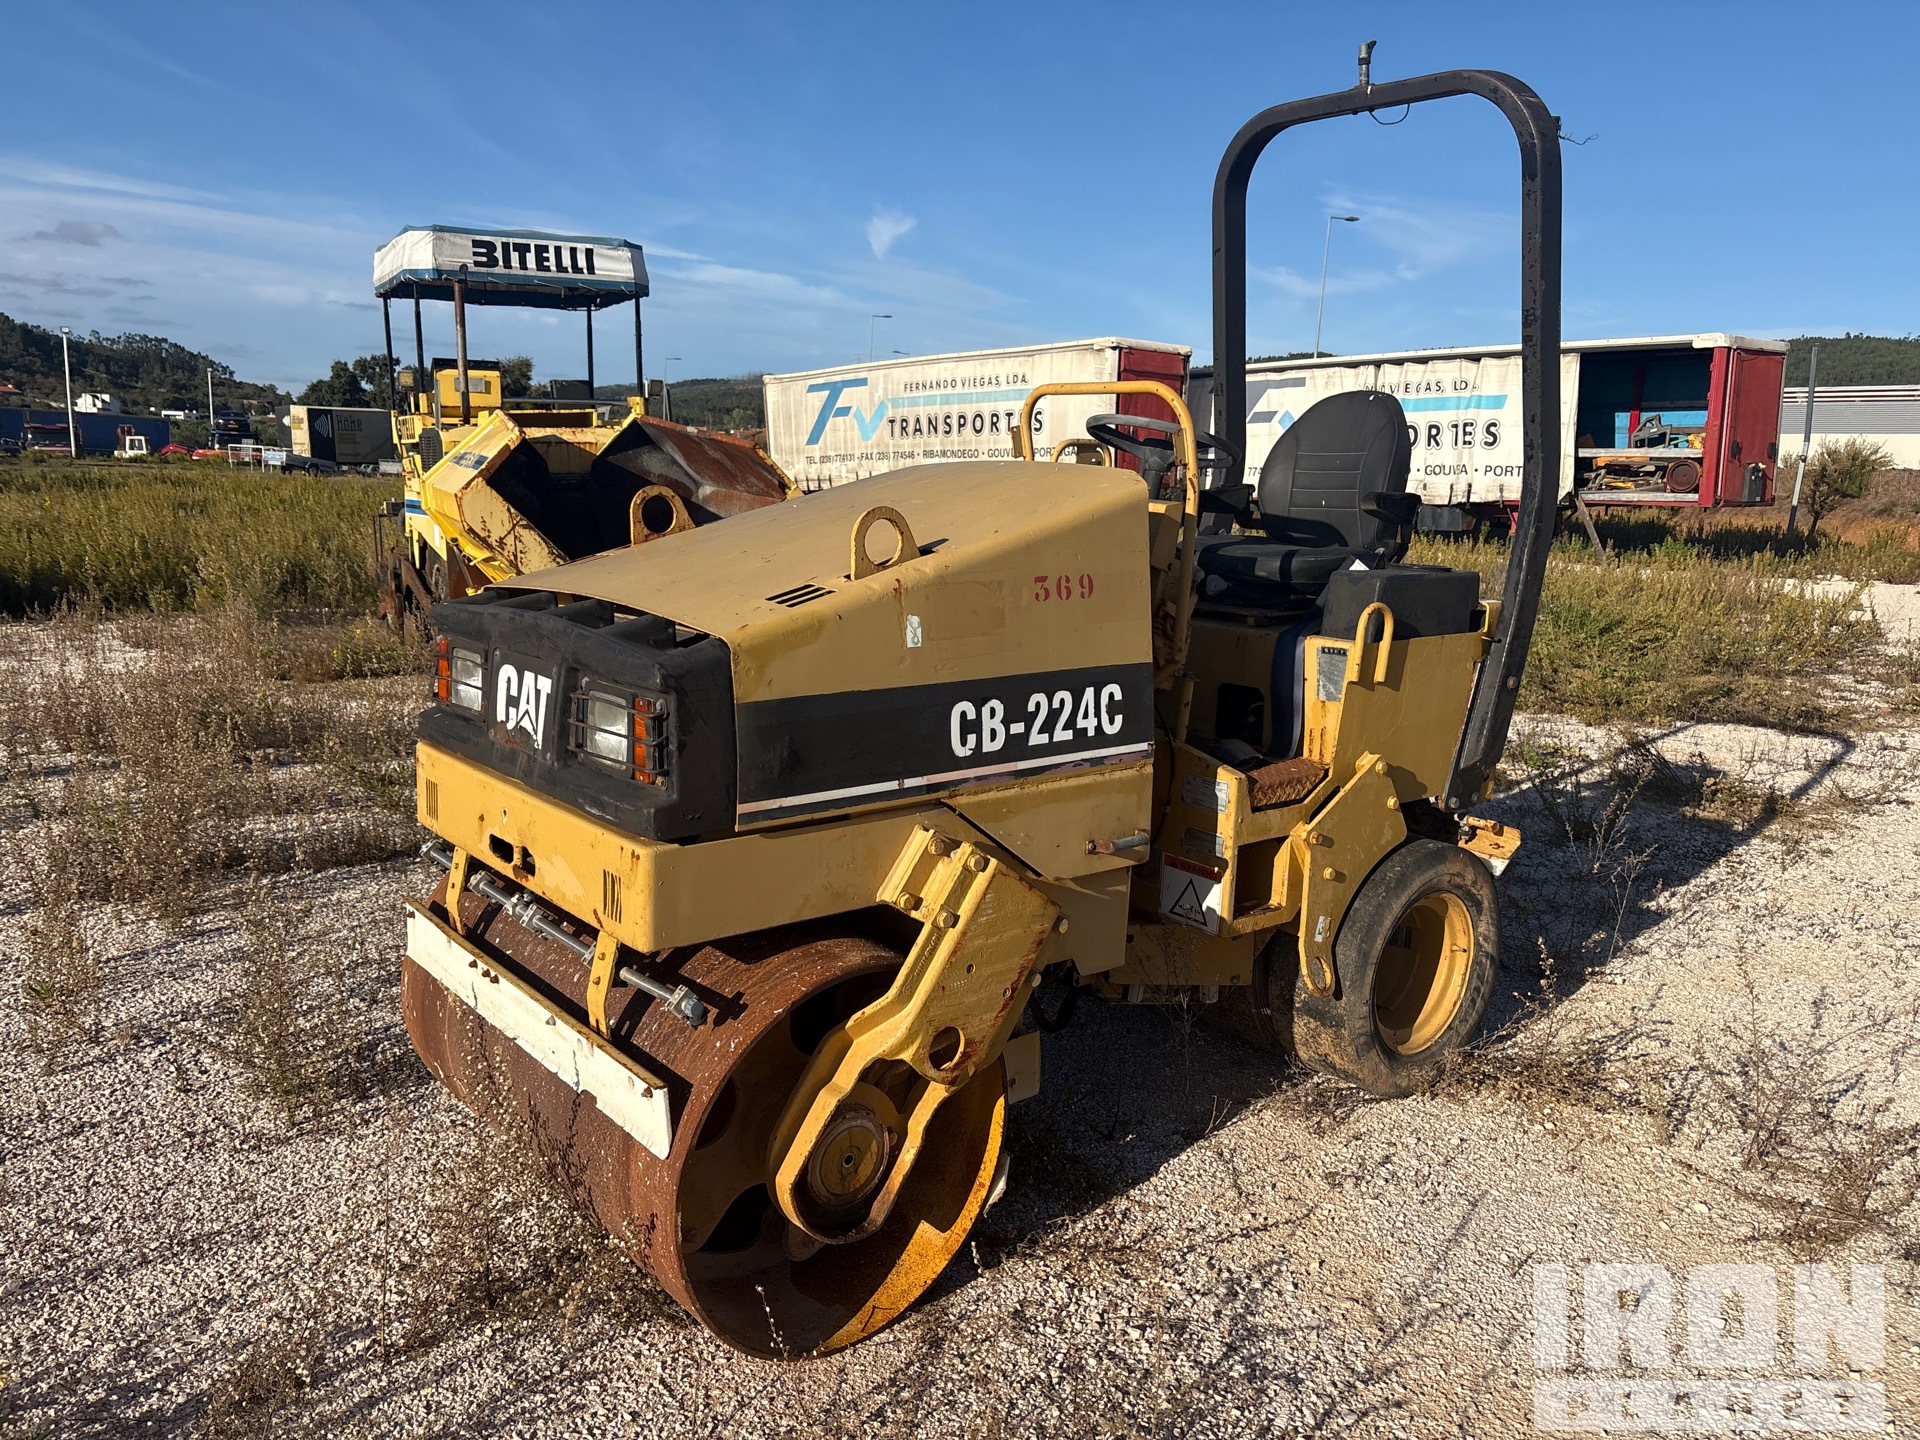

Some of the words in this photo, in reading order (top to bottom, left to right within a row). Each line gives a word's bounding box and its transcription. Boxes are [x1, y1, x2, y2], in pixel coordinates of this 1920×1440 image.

[472, 239, 597, 275] BITELLI
[903, 378, 957, 394] FERNANDO
[888, 409, 1044, 439] TRANSPORTS
[892, 450, 915, 461] 774546
[922, 448, 979, 459] RIBAMONDEGO
[1484, 465, 1523, 477] PORT
[1034, 573, 1094, 602] 369
[497, 663, 553, 750] CAT
[950, 683, 1124, 758] CB-224C
[1180, 860, 1218, 881] WARNING
